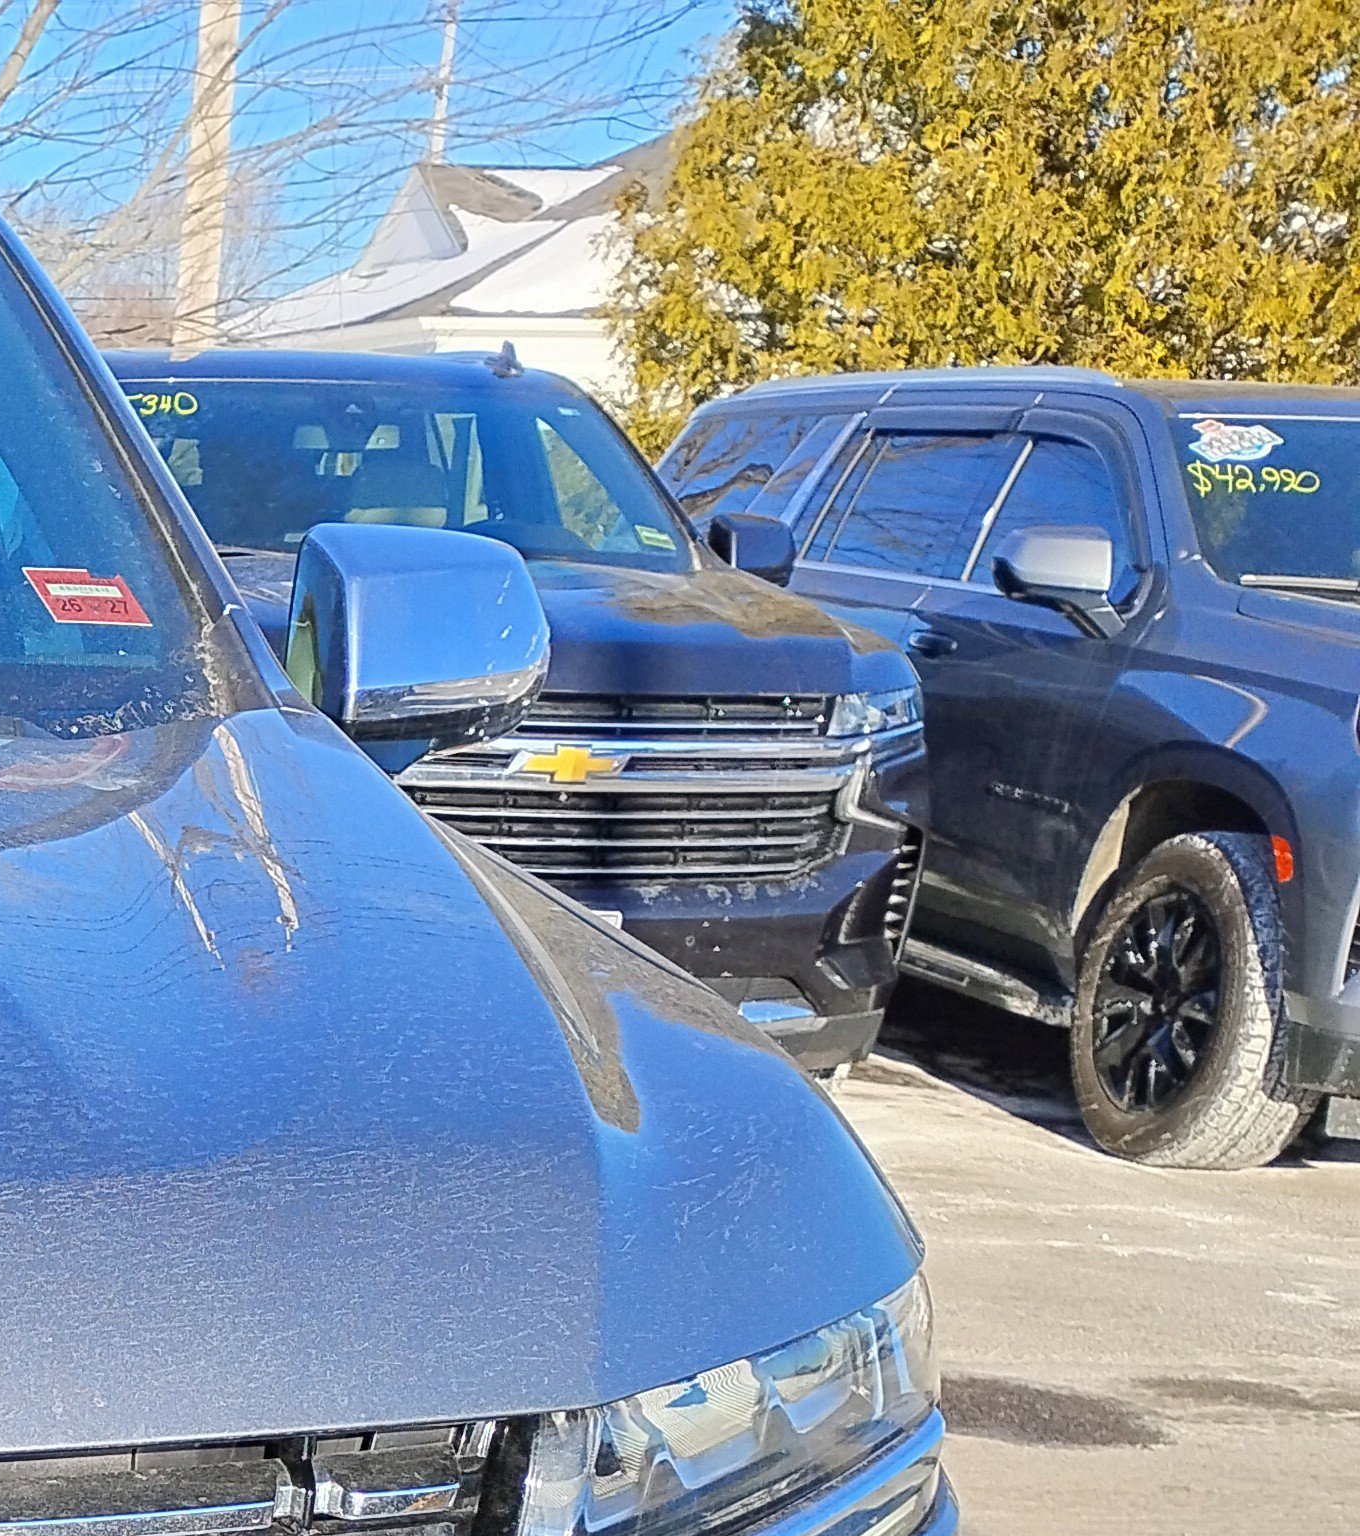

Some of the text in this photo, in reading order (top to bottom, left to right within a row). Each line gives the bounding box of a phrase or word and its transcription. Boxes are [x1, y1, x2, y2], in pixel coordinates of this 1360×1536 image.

[126, 391, 198, 416] 340
[57, 598, 129, 614] 26 27
